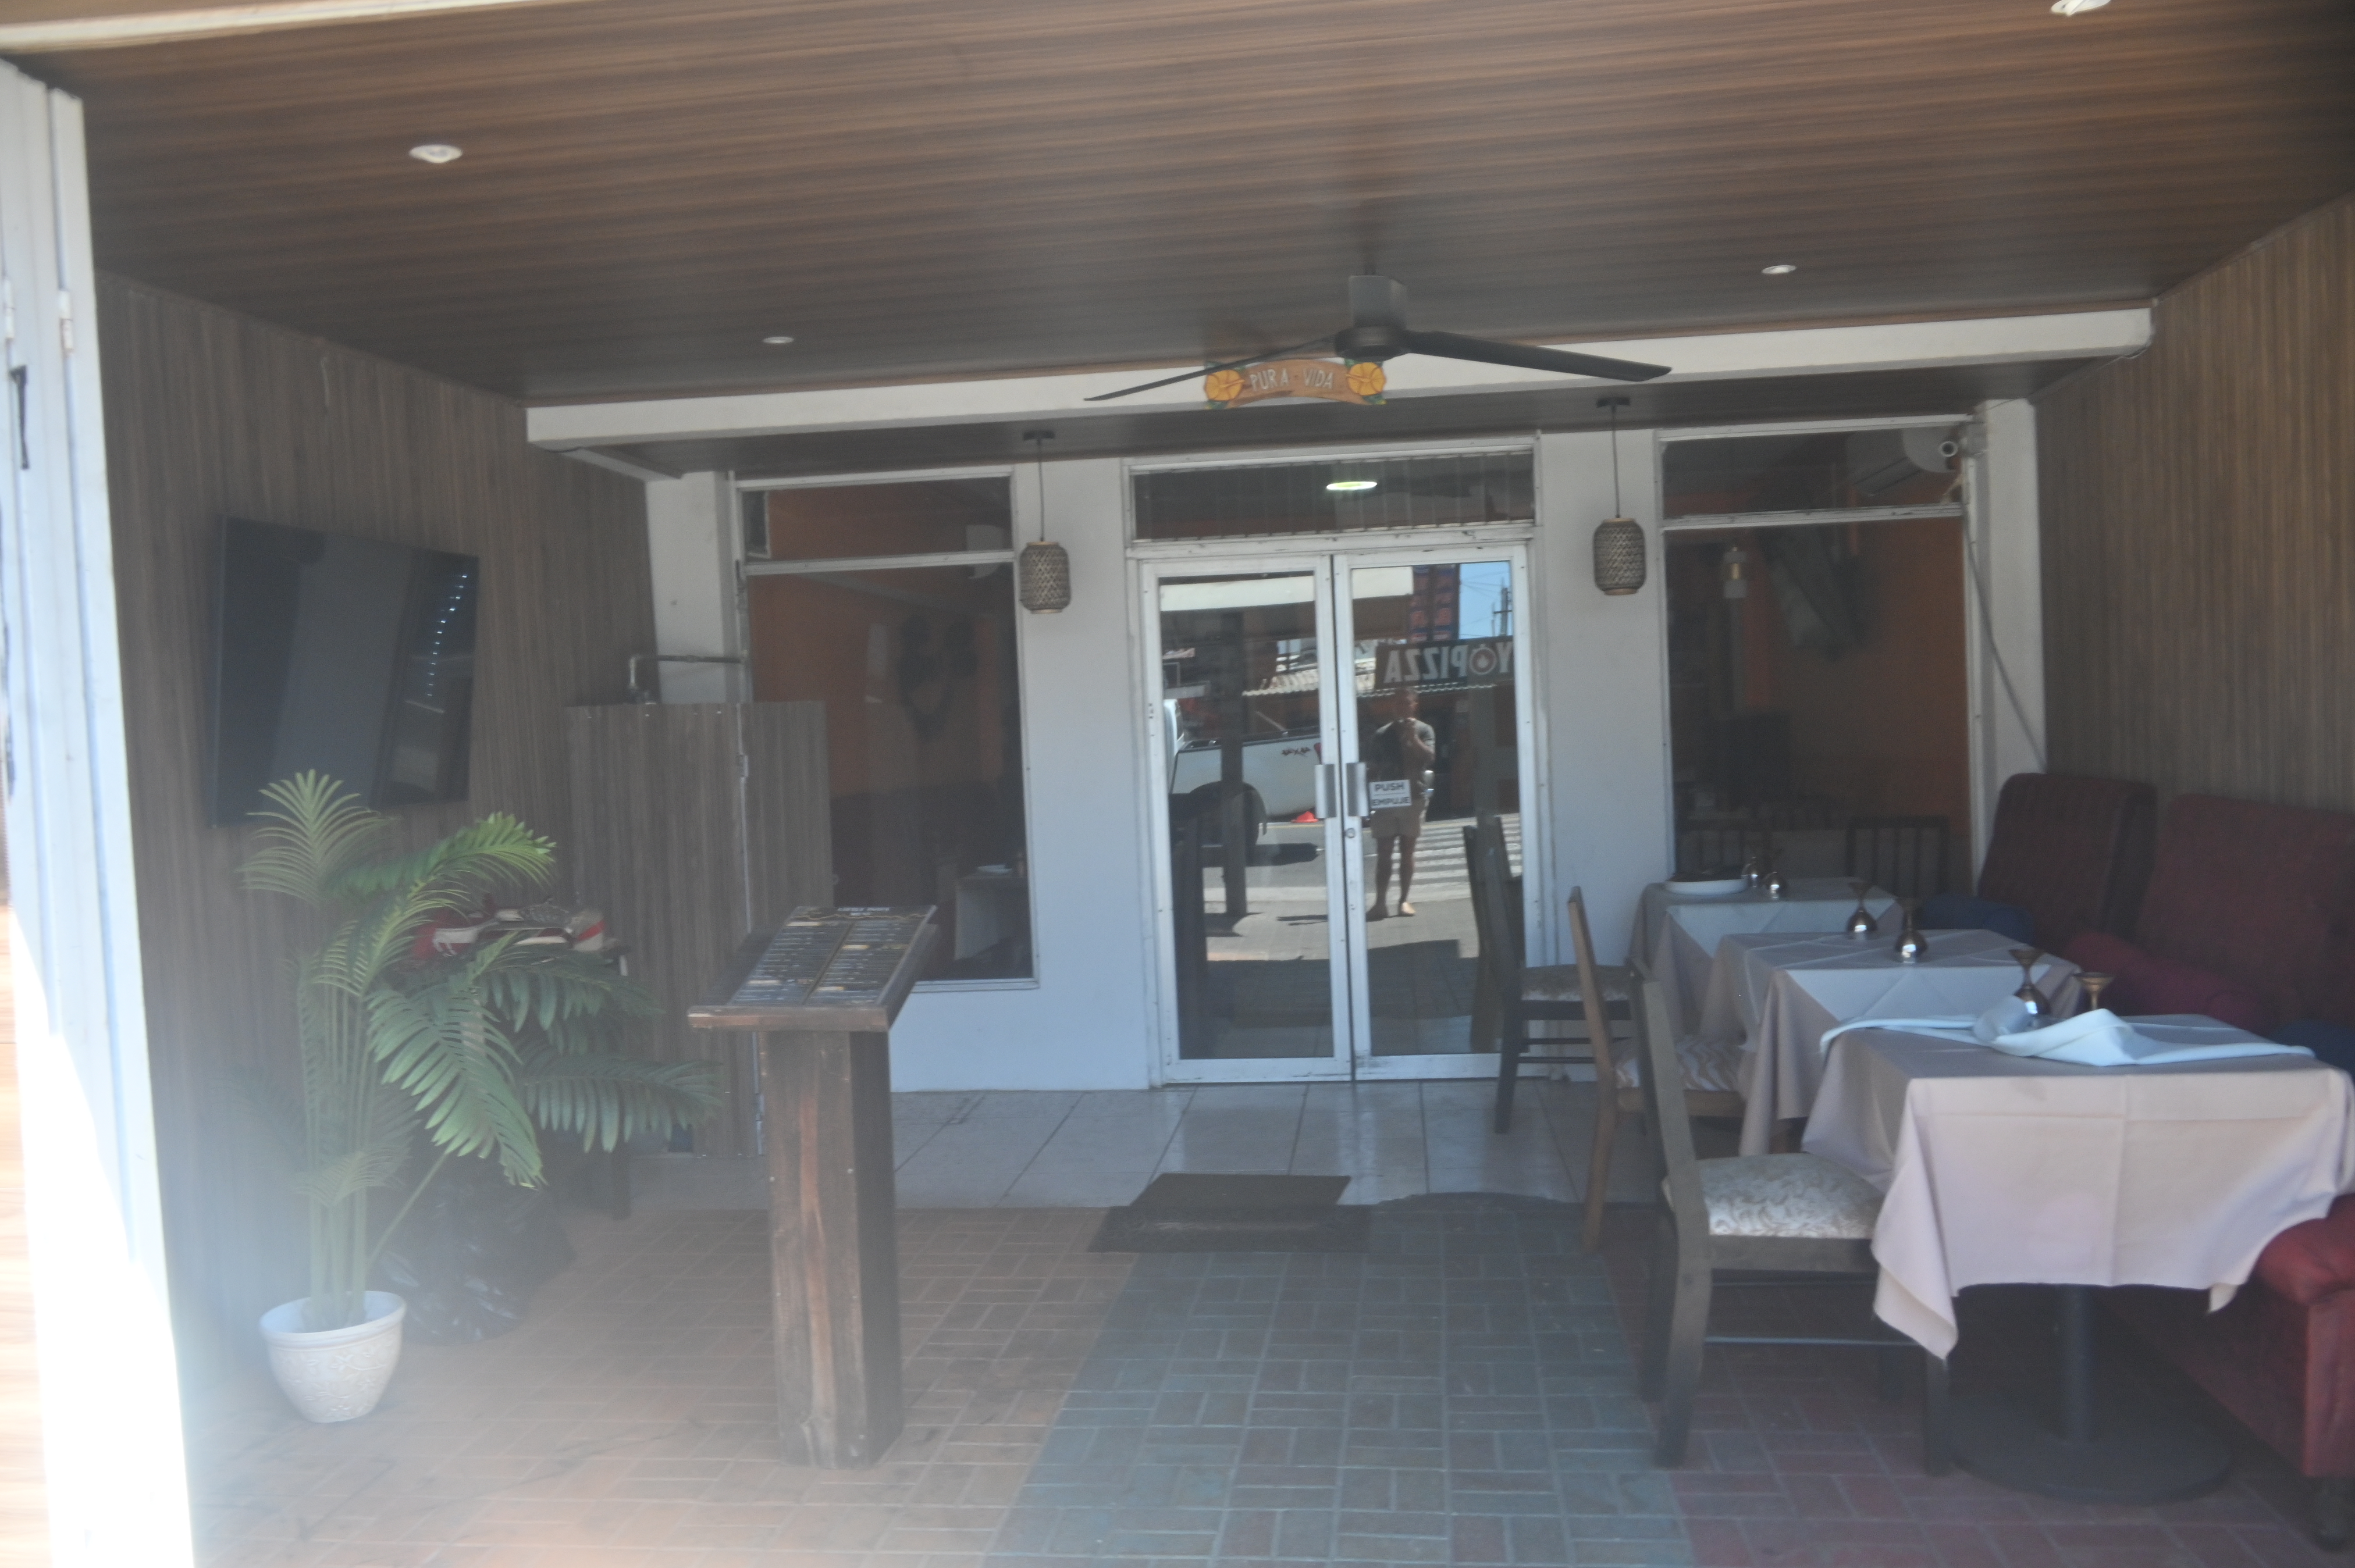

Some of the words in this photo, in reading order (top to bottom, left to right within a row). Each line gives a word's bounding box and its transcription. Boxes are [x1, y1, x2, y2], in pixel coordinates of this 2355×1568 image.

[1249, 368, 1289, 391] PURA
[1303, 368, 1333, 389] VIDA
[1375, 782, 1404, 791] PUSH
